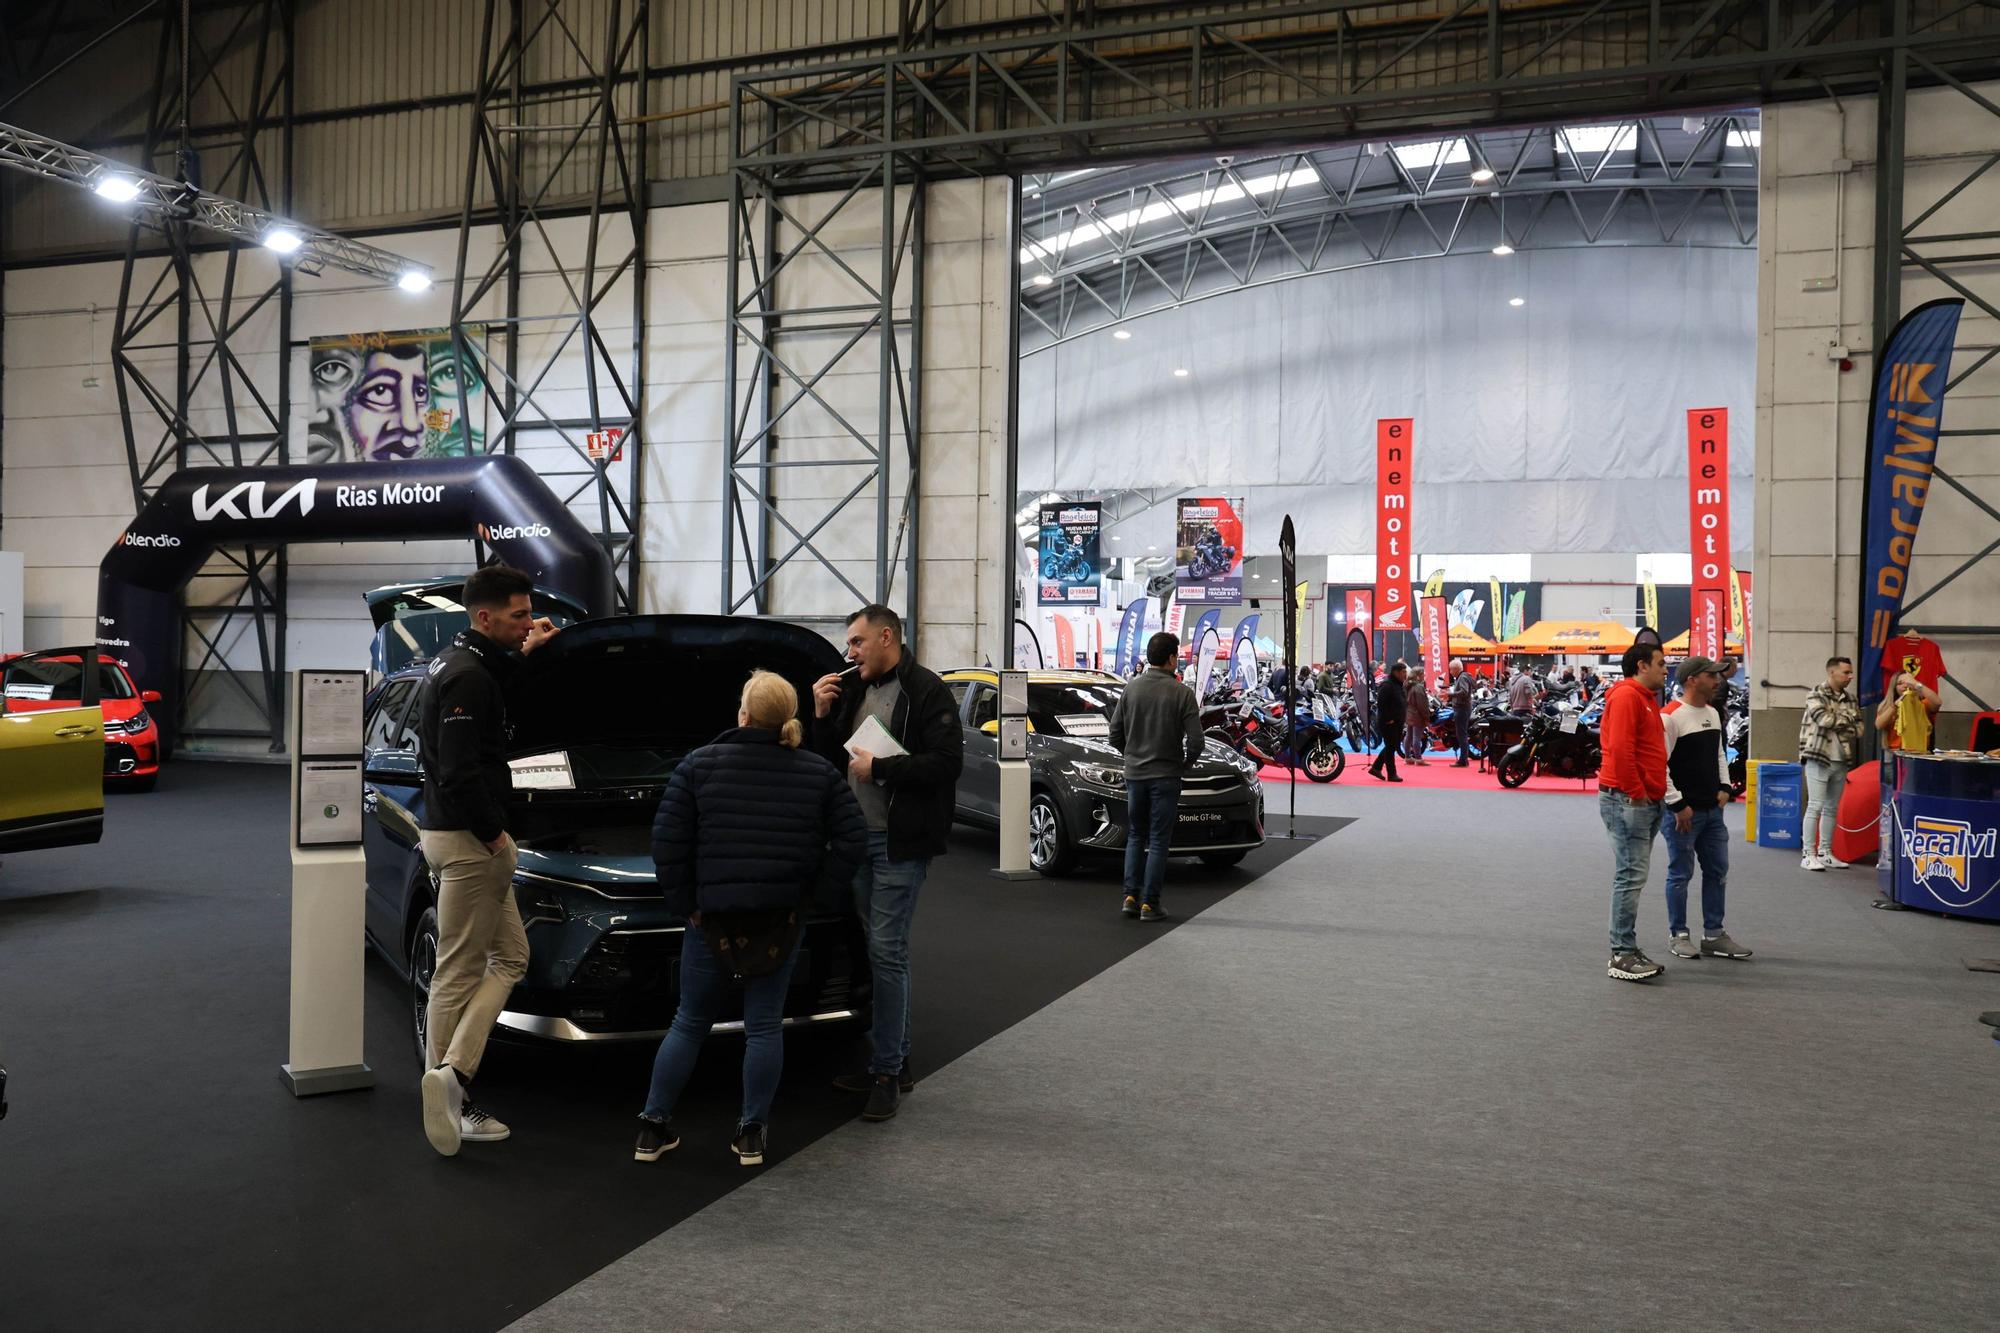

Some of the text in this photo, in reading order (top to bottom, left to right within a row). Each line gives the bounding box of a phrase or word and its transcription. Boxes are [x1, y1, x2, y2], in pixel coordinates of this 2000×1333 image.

[336, 486, 377, 507] Rias
[382, 482, 445, 505] Motor
[1697, 413, 1720, 579] enemoto
[1384, 424, 1405, 602] enemotos
[125, 532, 181, 547] blendio
[489, 523, 551, 540] blendio
[1169, 603, 1182, 632] YAMA
[1124, 610, 1138, 663] LINHAI
[1179, 812, 1222, 822] Stonic GT-line
[1901, 828, 1997, 858] Recalvi
